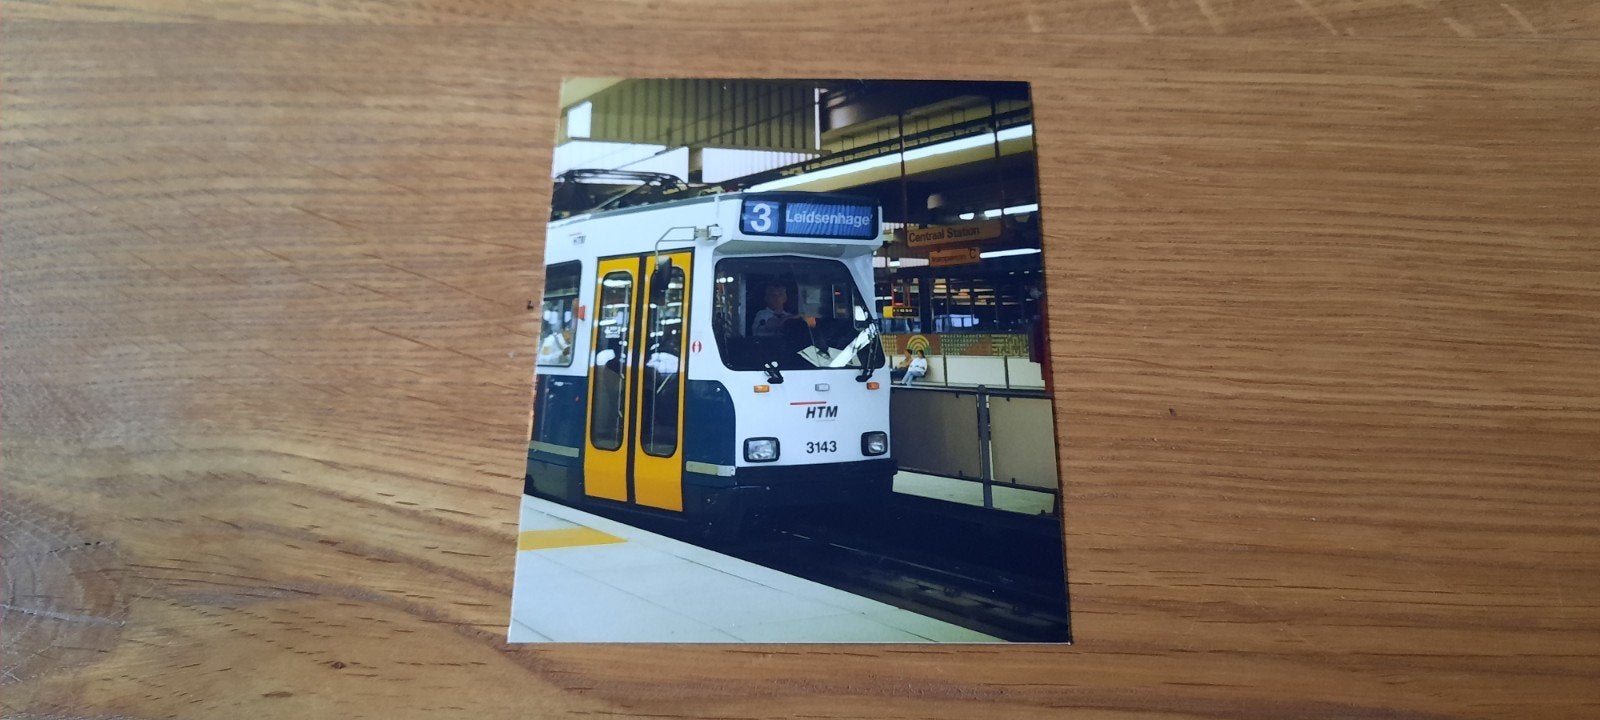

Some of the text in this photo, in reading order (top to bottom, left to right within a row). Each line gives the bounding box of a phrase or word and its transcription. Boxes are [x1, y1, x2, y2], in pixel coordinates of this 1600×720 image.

[750, 202, 772, 232] 3
[908, 226, 980, 243] Centraal Station
[806, 405, 838, 419] HTM
[806, 440, 838, 454] 3143
